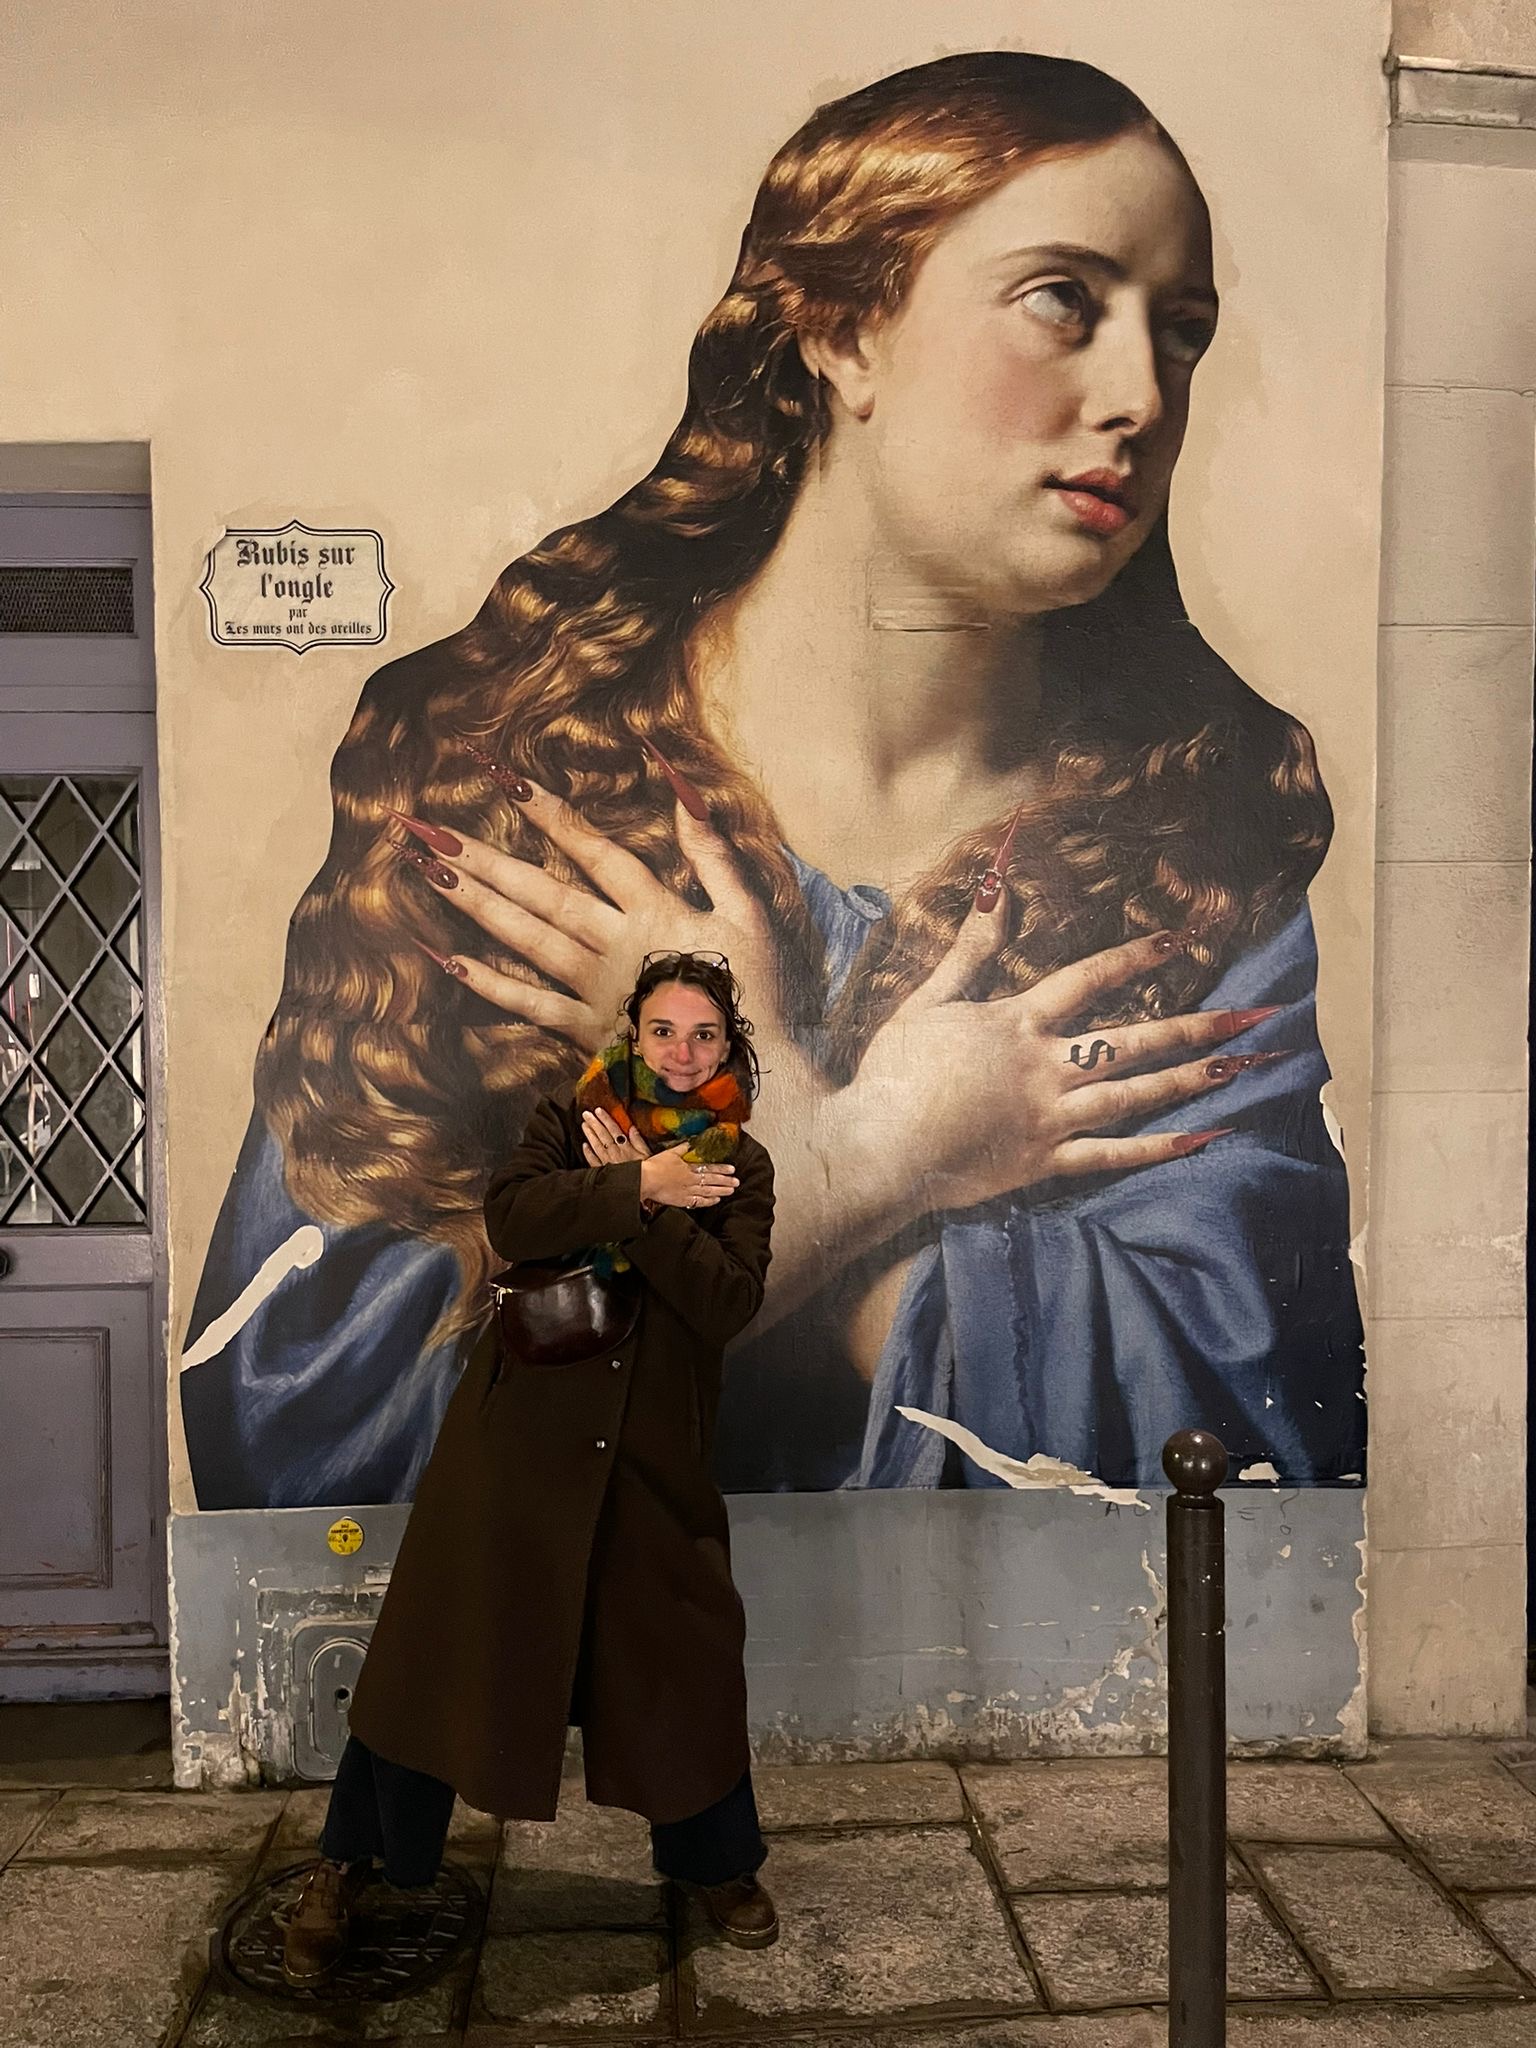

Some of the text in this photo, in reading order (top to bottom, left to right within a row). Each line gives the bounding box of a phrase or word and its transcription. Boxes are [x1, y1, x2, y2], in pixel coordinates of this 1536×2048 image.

[236, 539, 355, 569] Rubis sur
[261, 573, 333, 604] l'ongle
[289, 608, 307, 621] par
[225, 621, 372, 635] Les murs ont des oreilles
